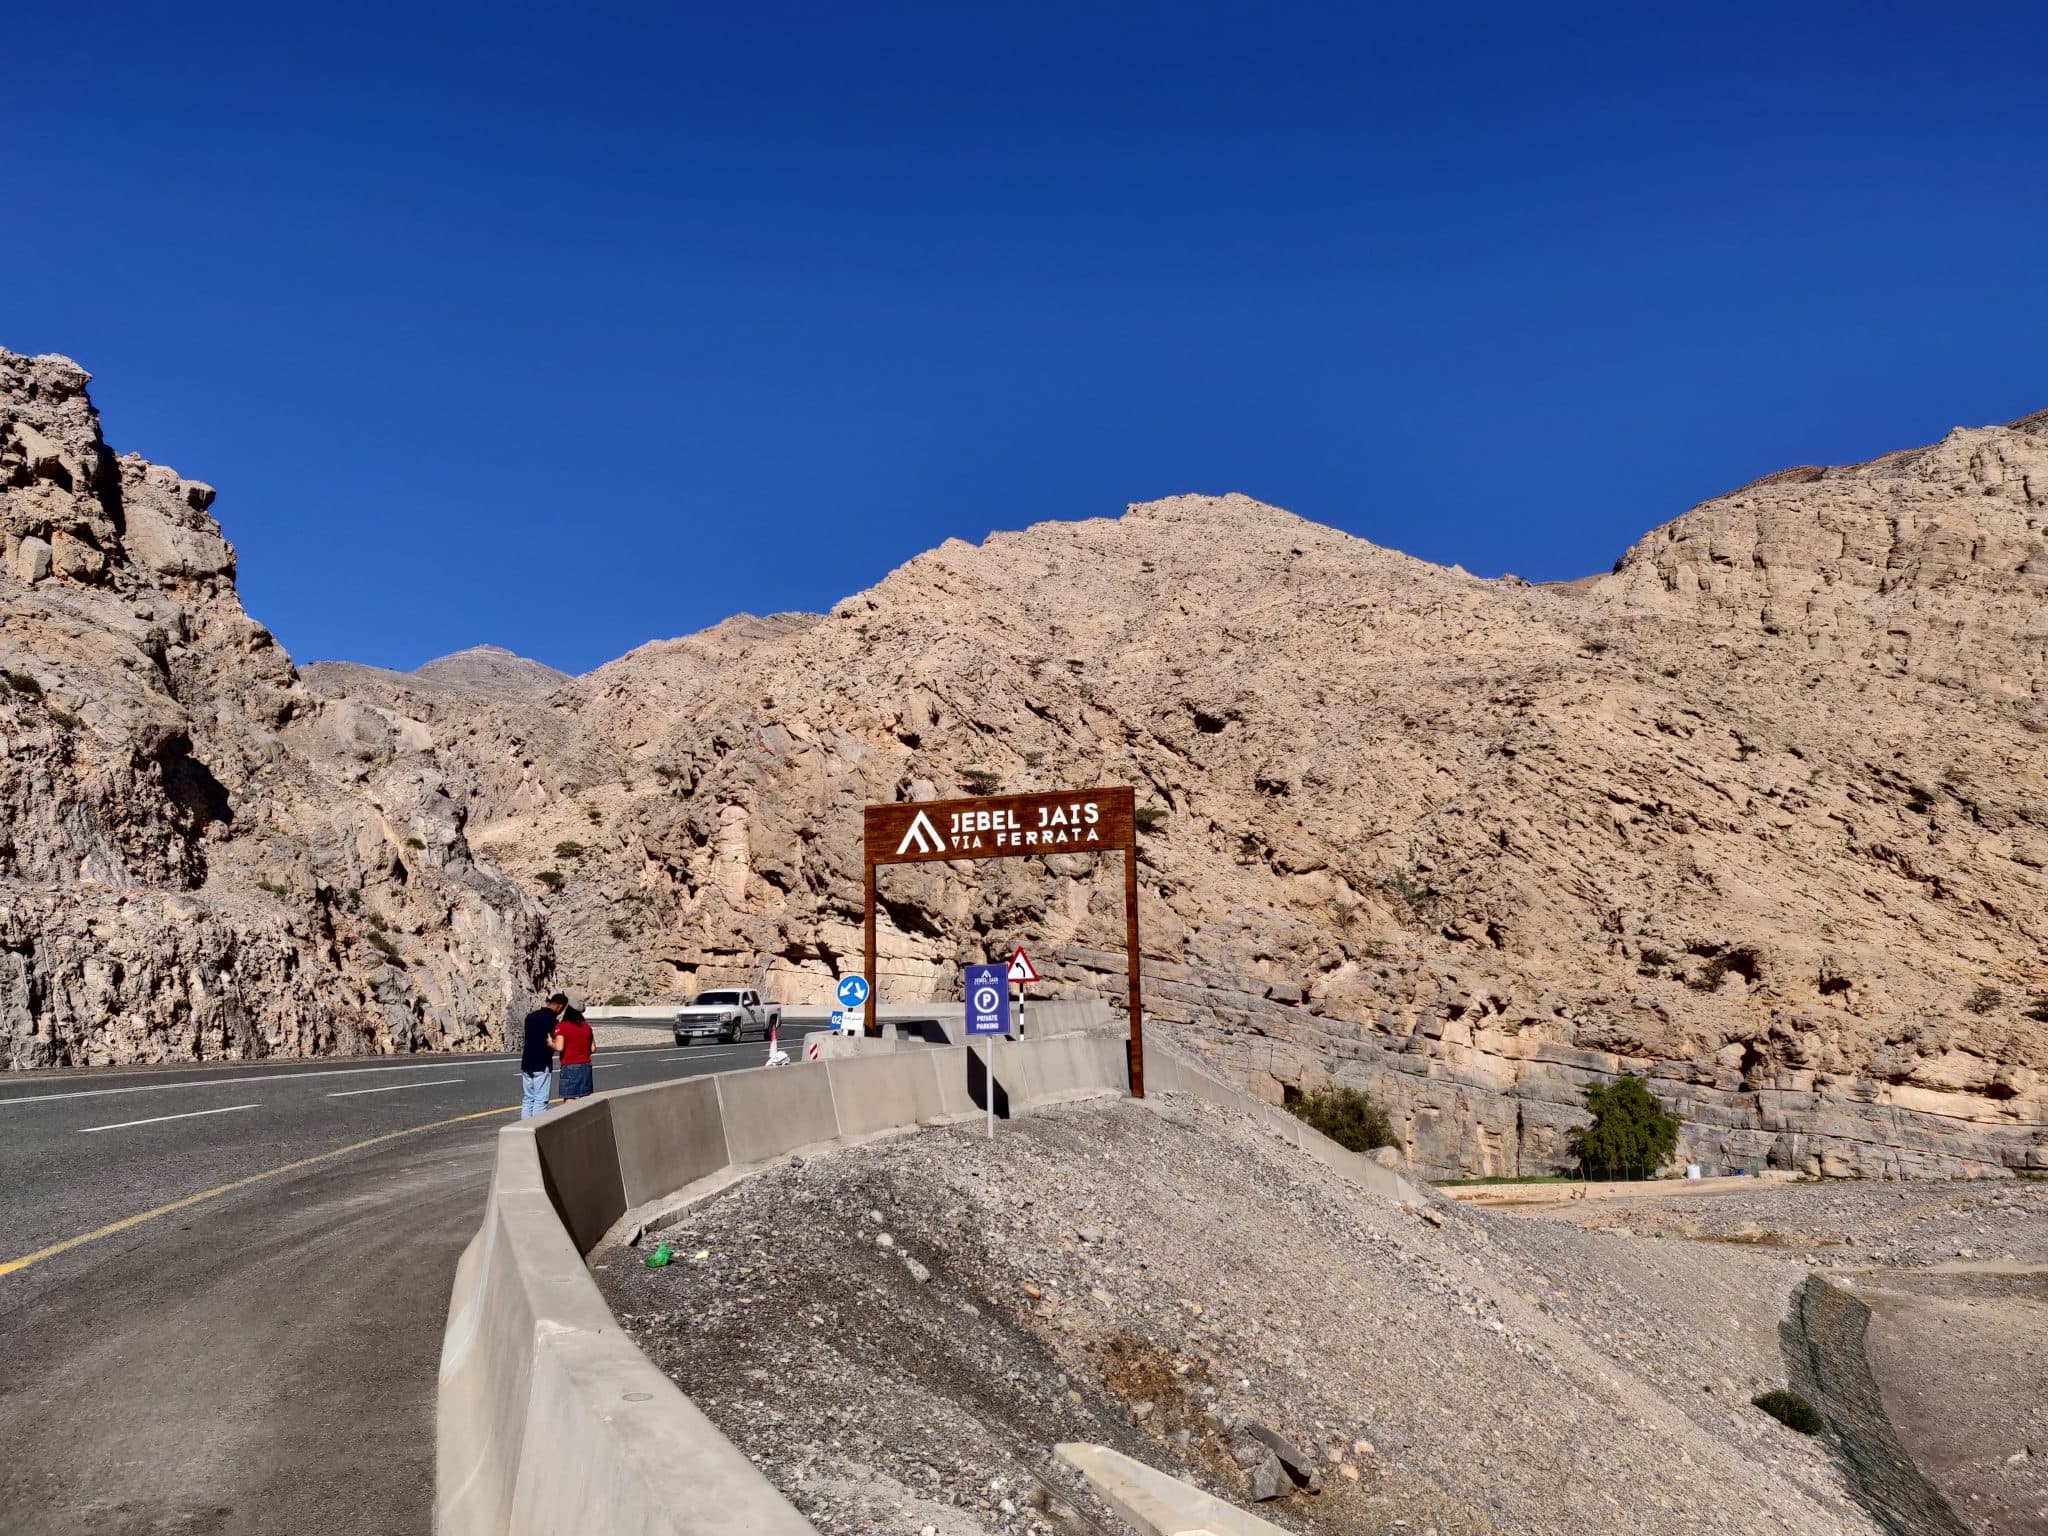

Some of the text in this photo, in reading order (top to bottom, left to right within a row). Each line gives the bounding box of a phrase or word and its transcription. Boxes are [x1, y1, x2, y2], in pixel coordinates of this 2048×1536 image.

[951, 802, 1099, 833] JEBEL JAIS
[951, 827, 1099, 849] VIA FERRATA
[983, 993, 991, 1007] P
[832, 1015, 841, 1024] 02
